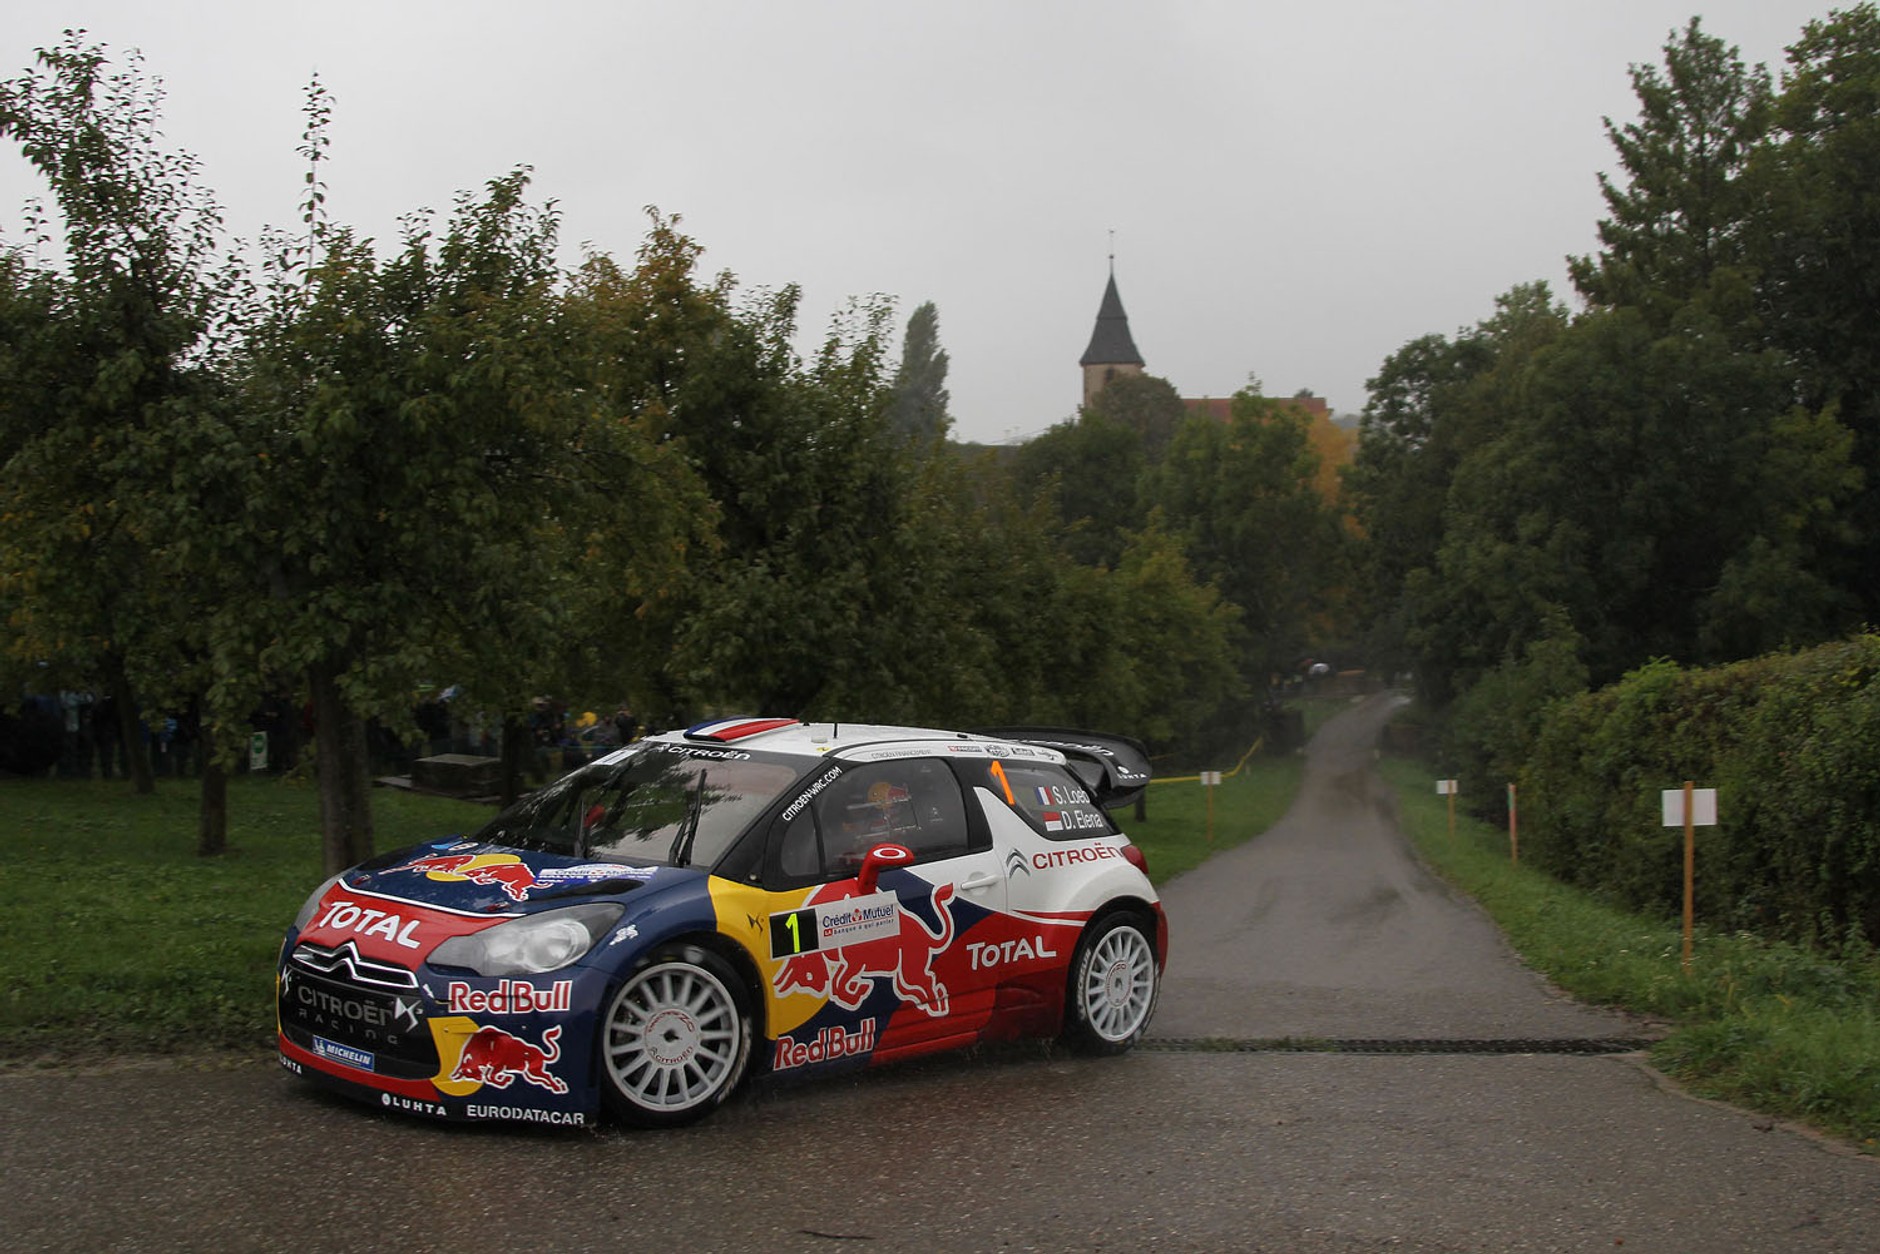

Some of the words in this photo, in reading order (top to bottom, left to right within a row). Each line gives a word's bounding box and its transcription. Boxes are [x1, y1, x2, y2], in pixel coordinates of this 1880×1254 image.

[990, 760, 1015, 806] 1
[1052, 785, 1067, 805] S.
[1063, 785, 1091, 805] Loeb
[1061, 810, 1077, 830] D.
[1074, 809, 1104, 829] Elena
[1032, 842, 1123, 869] CITROËN
[319, 901, 421, 950] TOTAL
[822, 912, 851, 928] Crédit
[863, 903, 894, 921] Mutuel
[785, 912, 800, 954] 1
[966, 935, 1057, 971] TOTAL
[448, 979, 510, 1014] Red
[511, 979, 573, 1014] Bull
[326, 1044, 371, 1065] MICHELIN
[773, 1027, 827, 1071] Red
[826, 1016, 876, 1060] Bull
[393, 1101, 447, 1116] LUHTA
[466, 1104, 585, 1125] EURODATACAR
